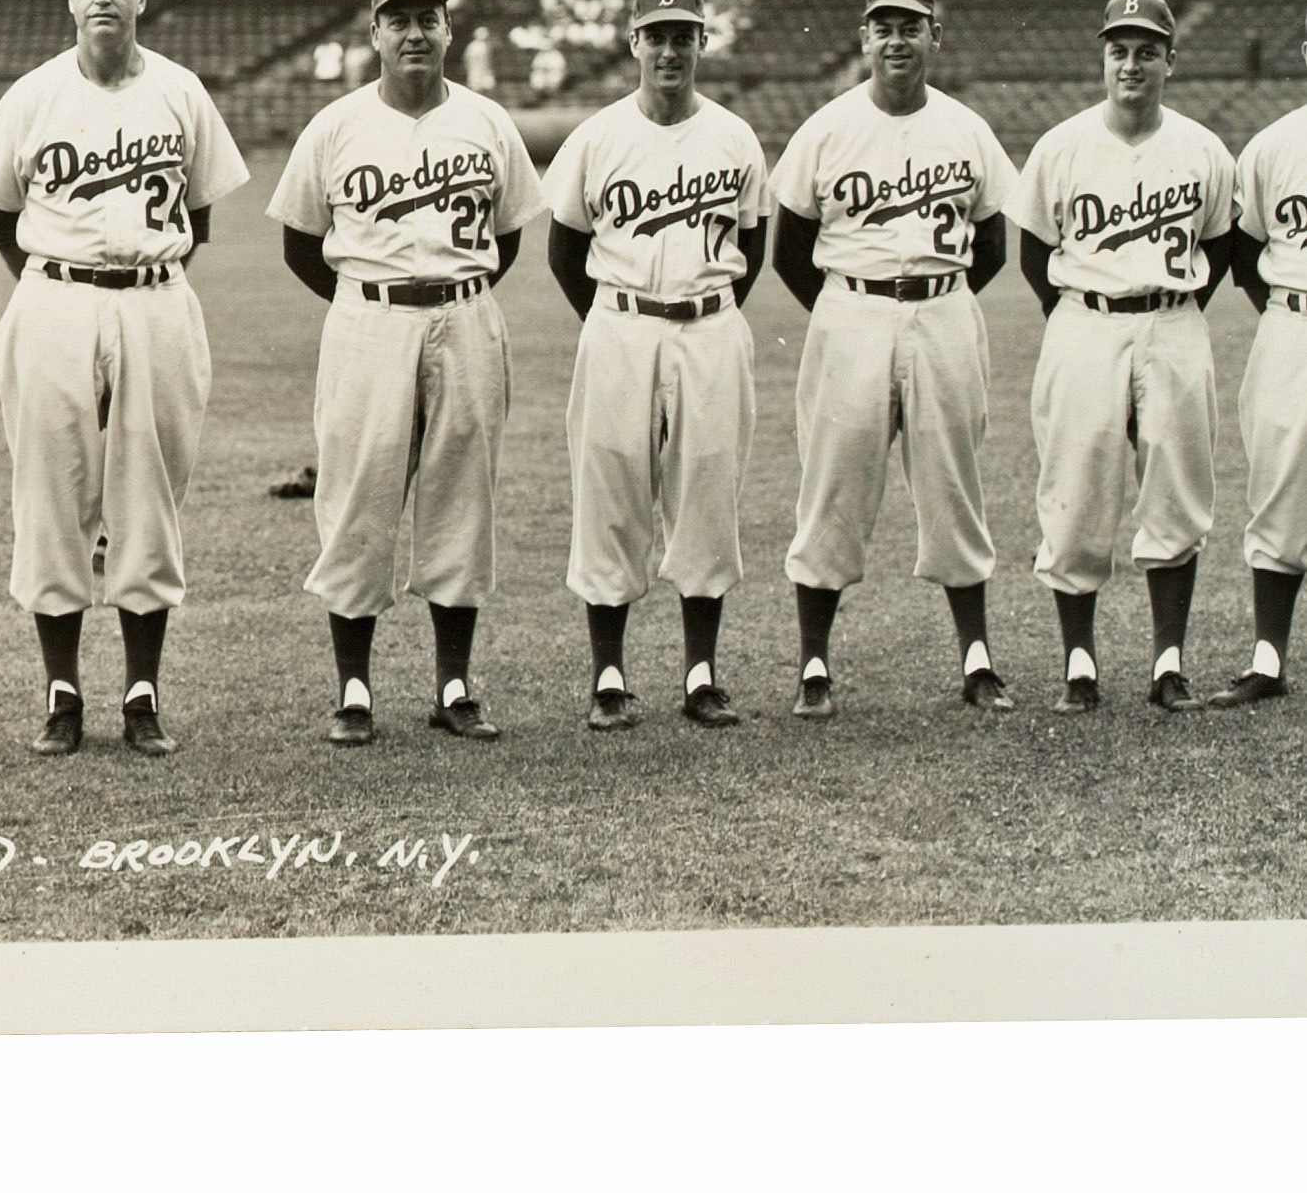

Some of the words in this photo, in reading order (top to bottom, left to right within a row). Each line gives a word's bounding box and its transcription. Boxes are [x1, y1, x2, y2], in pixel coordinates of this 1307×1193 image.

[36, 128, 185, 203] Dodgers
[342, 148, 495, 223] Dodgers
[603, 164, 743, 239] Dodgers
[831, 158, 975, 227] Dodgers
[450, 196, 492, 250] 22
[700, 213, 734, 263] 17
[1072, 181, 1203, 253] Dodgers
